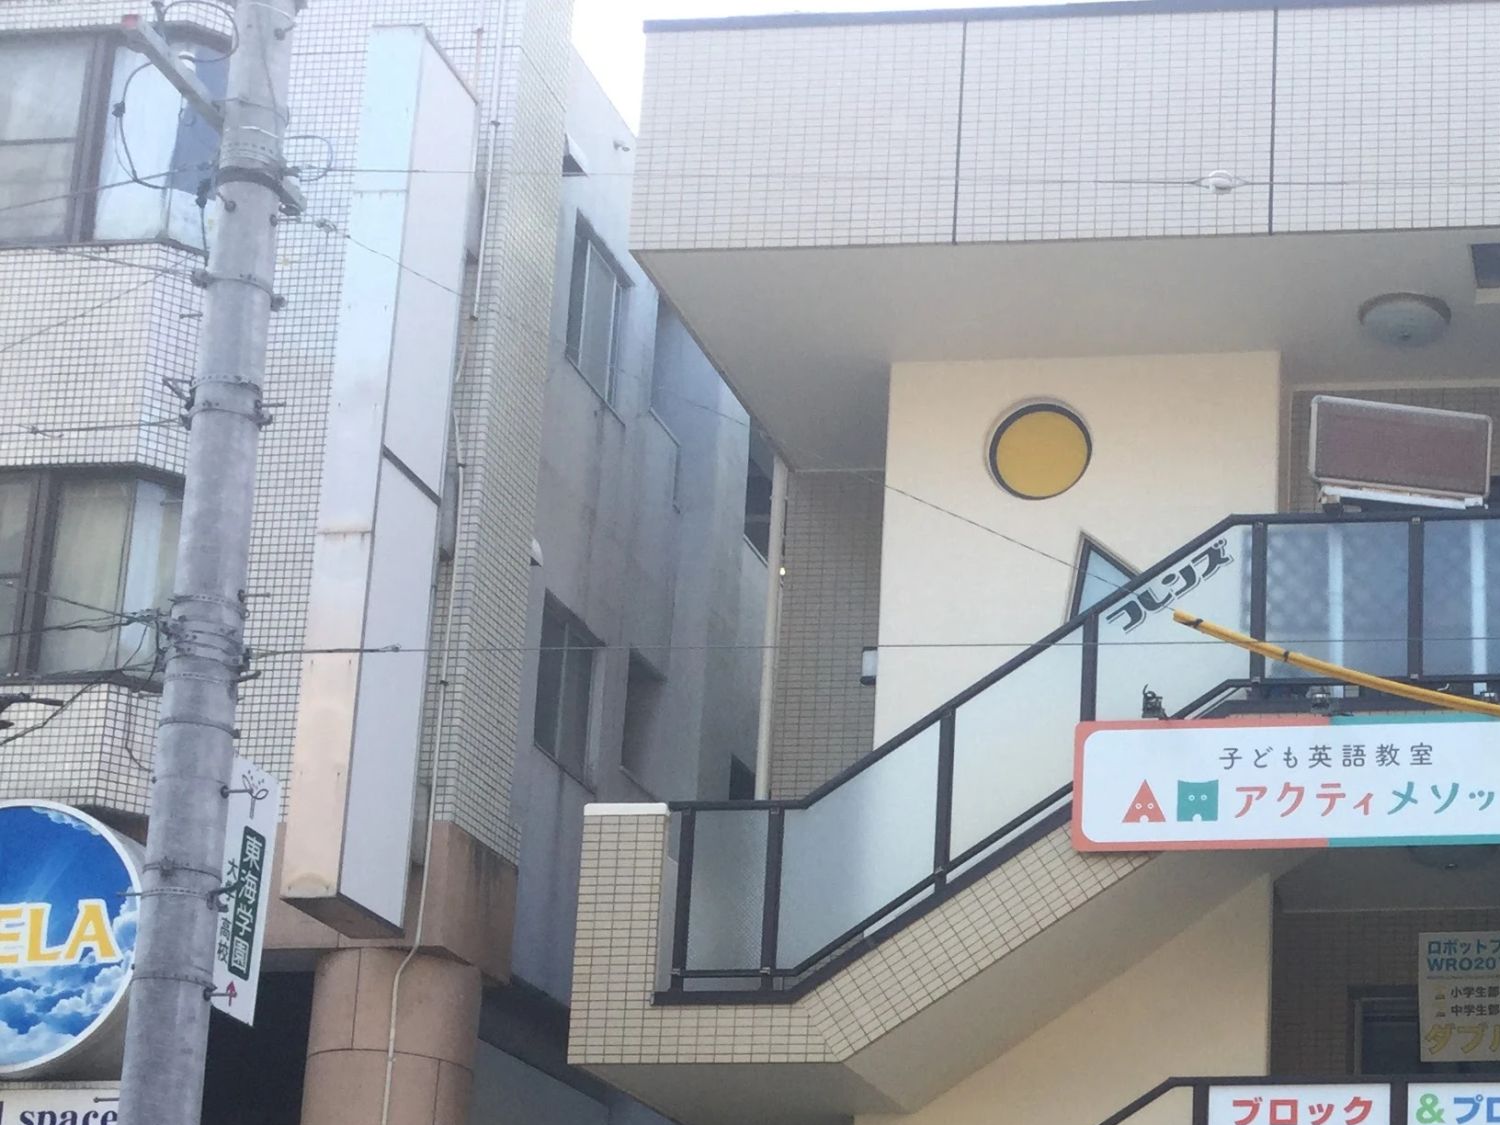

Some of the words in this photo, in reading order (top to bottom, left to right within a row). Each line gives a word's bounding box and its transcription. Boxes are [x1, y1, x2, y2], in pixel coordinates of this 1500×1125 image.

[1106, 538, 1235, 634] フレンズ
[1218, 743, 1435, 770] 子ども英語教室
